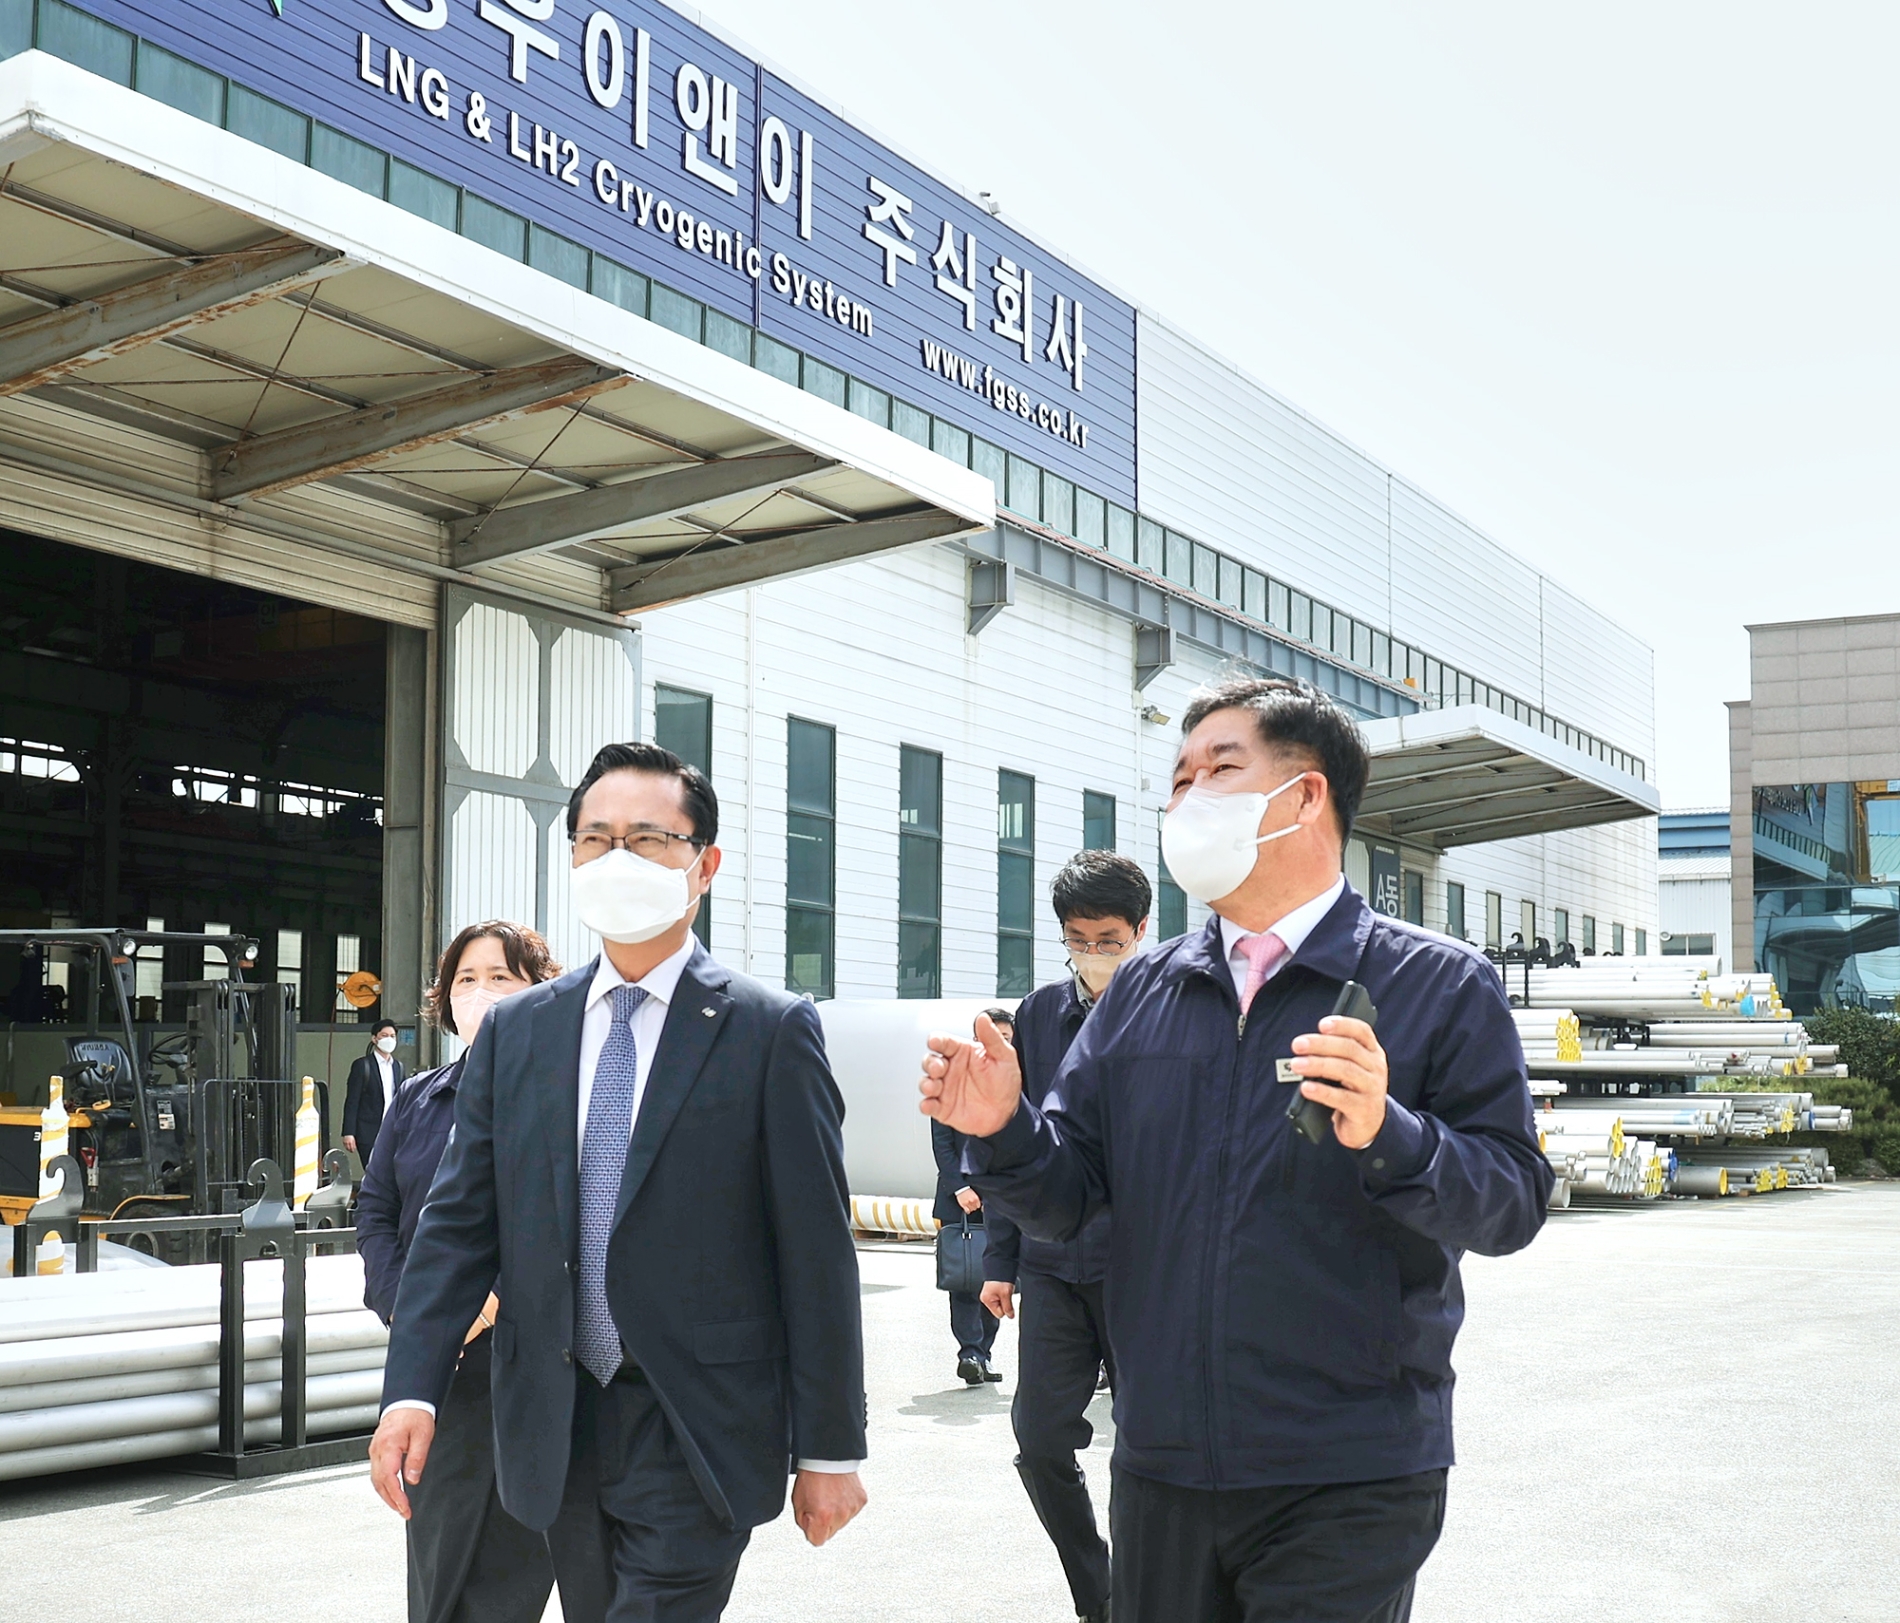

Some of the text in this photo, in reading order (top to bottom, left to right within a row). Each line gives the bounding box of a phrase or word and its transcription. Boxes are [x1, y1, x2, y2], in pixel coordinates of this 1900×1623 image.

[360, 32, 873, 337] LNG & LH2 Cryogenic System
[863, 175, 1088, 391] 주식회사
[921, 337, 1089, 449] www.fgss.co.kr
[1375, 873, 1399, 918] A동
